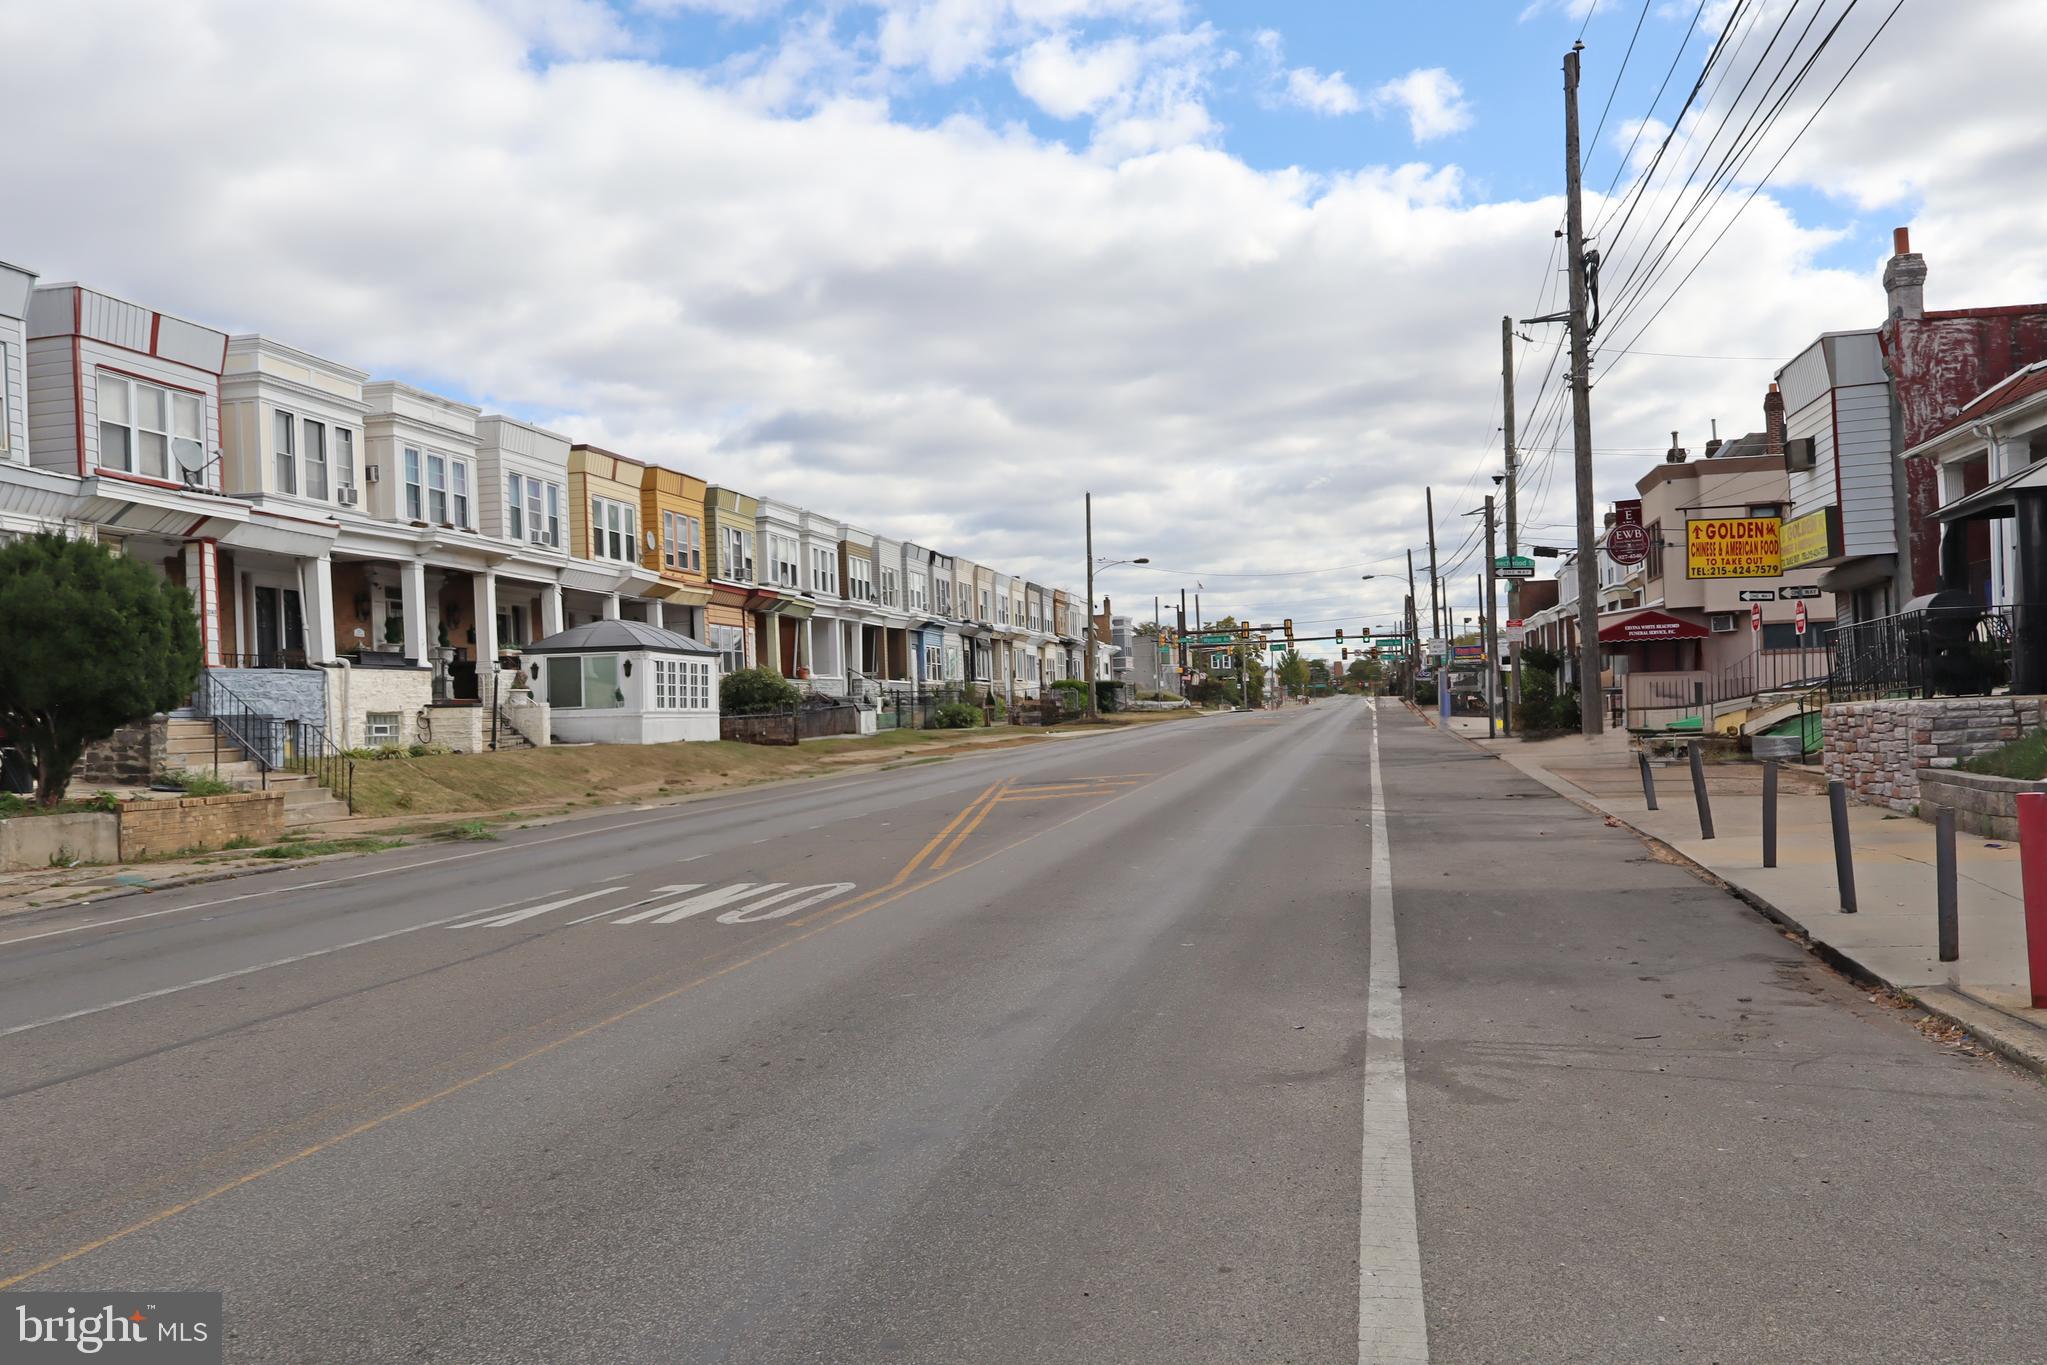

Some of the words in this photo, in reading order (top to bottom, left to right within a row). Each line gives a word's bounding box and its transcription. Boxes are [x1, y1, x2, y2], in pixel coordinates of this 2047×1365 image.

[1616, 529, 1642, 540] EWB
[1706, 522, 1764, 540] GOLDEN
[1691, 541, 1717, 558] CHINESE
[1718, 542, 1723, 556] &
[1725, 540, 1758, 557] AMERICAN
[1760, 540, 1779, 556] FOOD
[1706, 558, 1718, 566] TO
[1721, 557, 1743, 566] TAKE
[1745, 556, 1764, 565] OUT
[1691, 565, 1779, 576] TEL:215-424-7579
